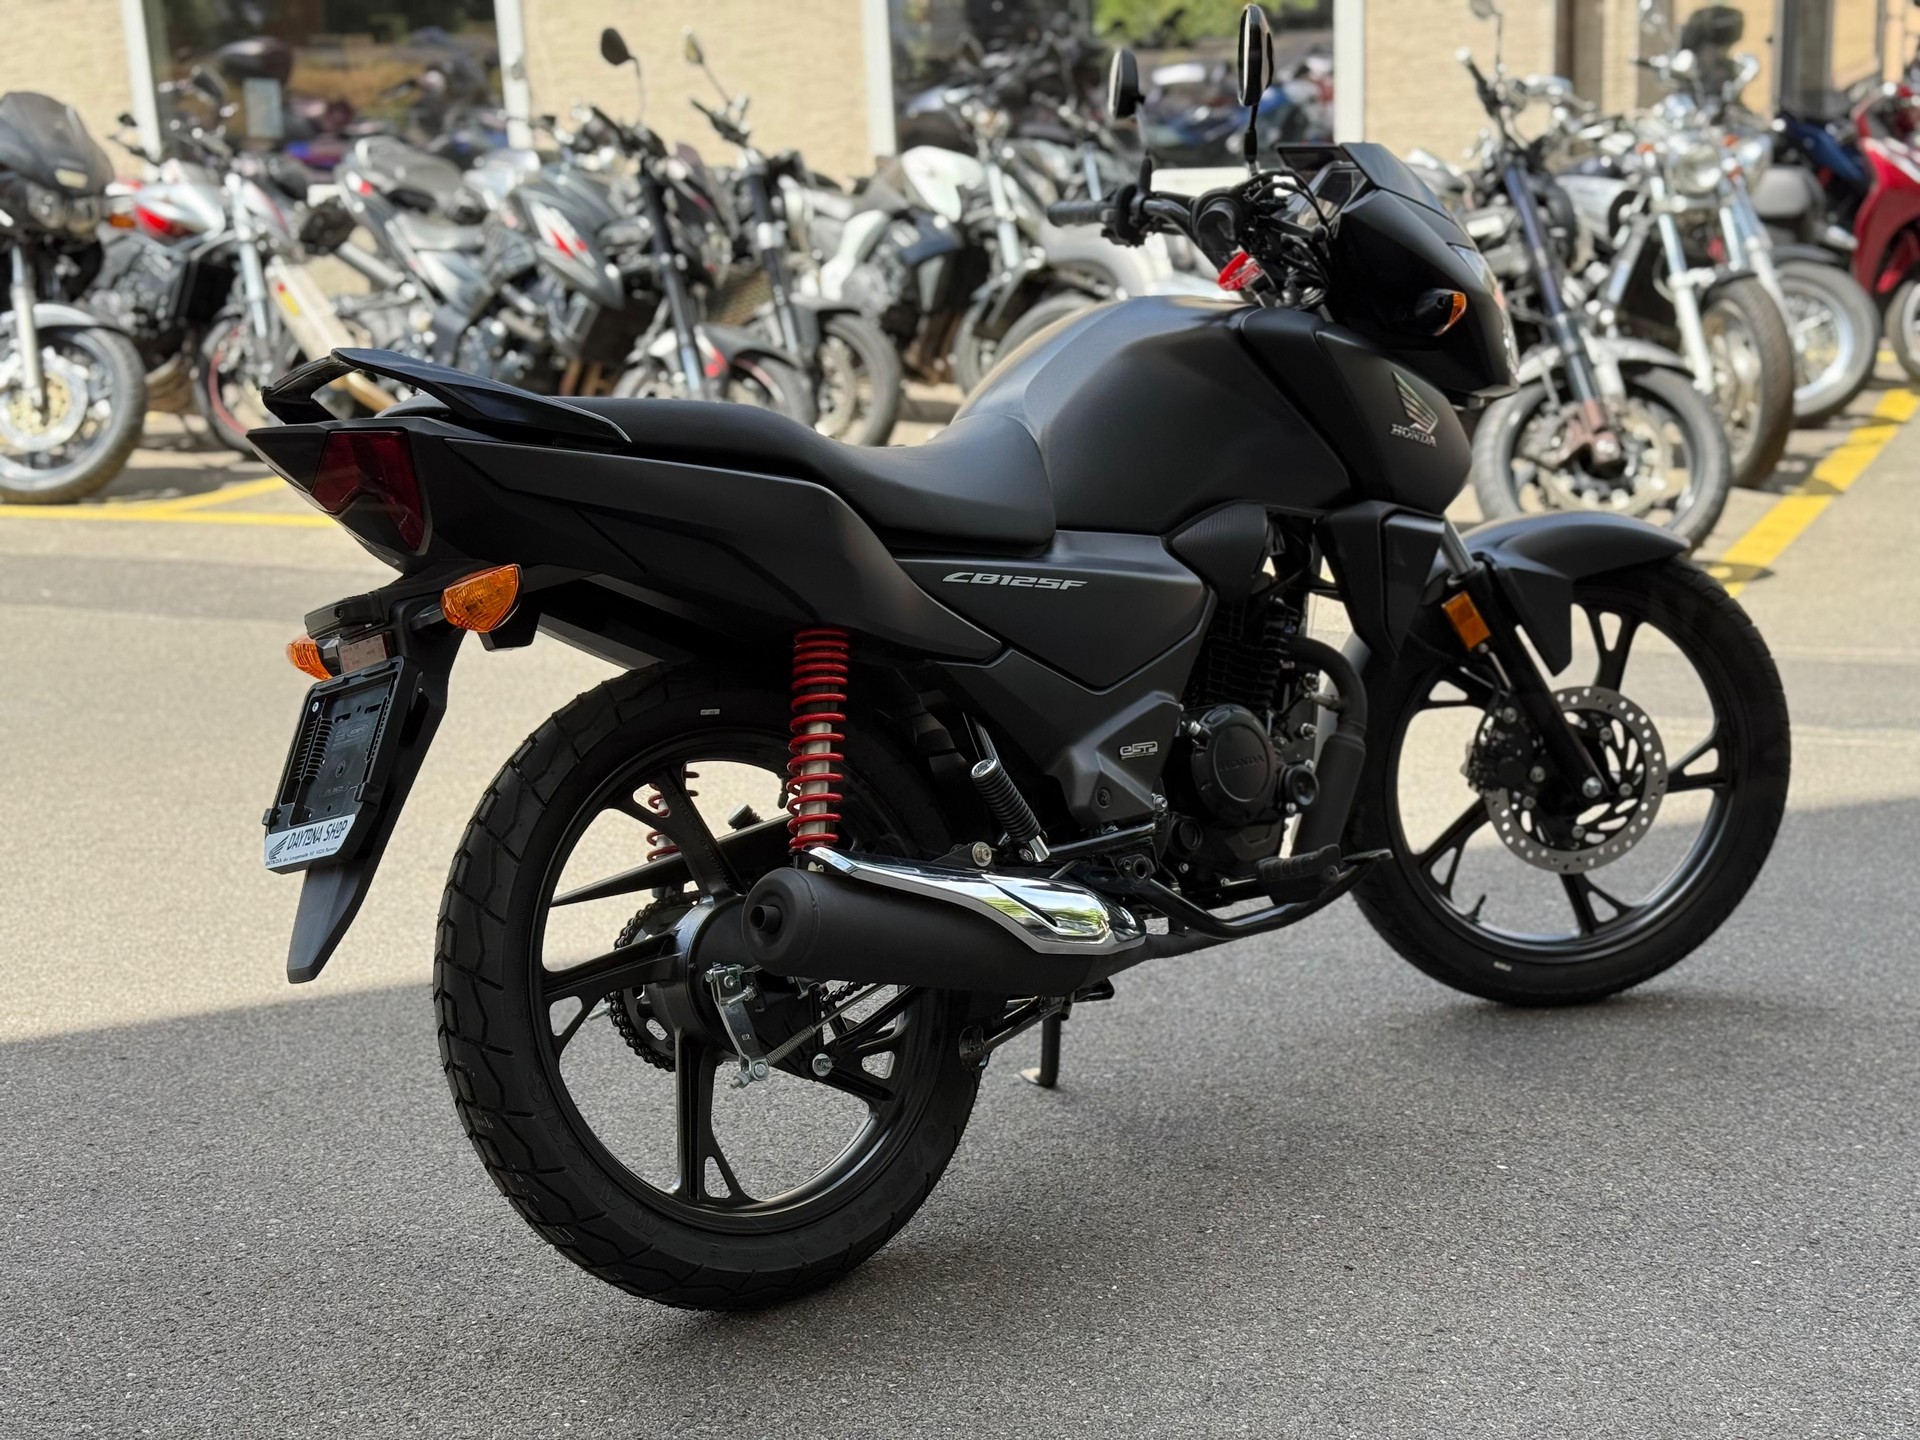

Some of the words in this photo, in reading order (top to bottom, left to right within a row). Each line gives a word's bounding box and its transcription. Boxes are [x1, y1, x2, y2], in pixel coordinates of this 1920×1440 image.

[1390, 423, 1438, 448] HONDA
[942, 571, 1088, 590] CB125F
[1219, 754, 1265, 772] HONDA
[286, 825, 324, 851] DAYTONA
[323, 819, 348, 842] SHOP
[527, 1071, 661, 1237] MAXXIS
